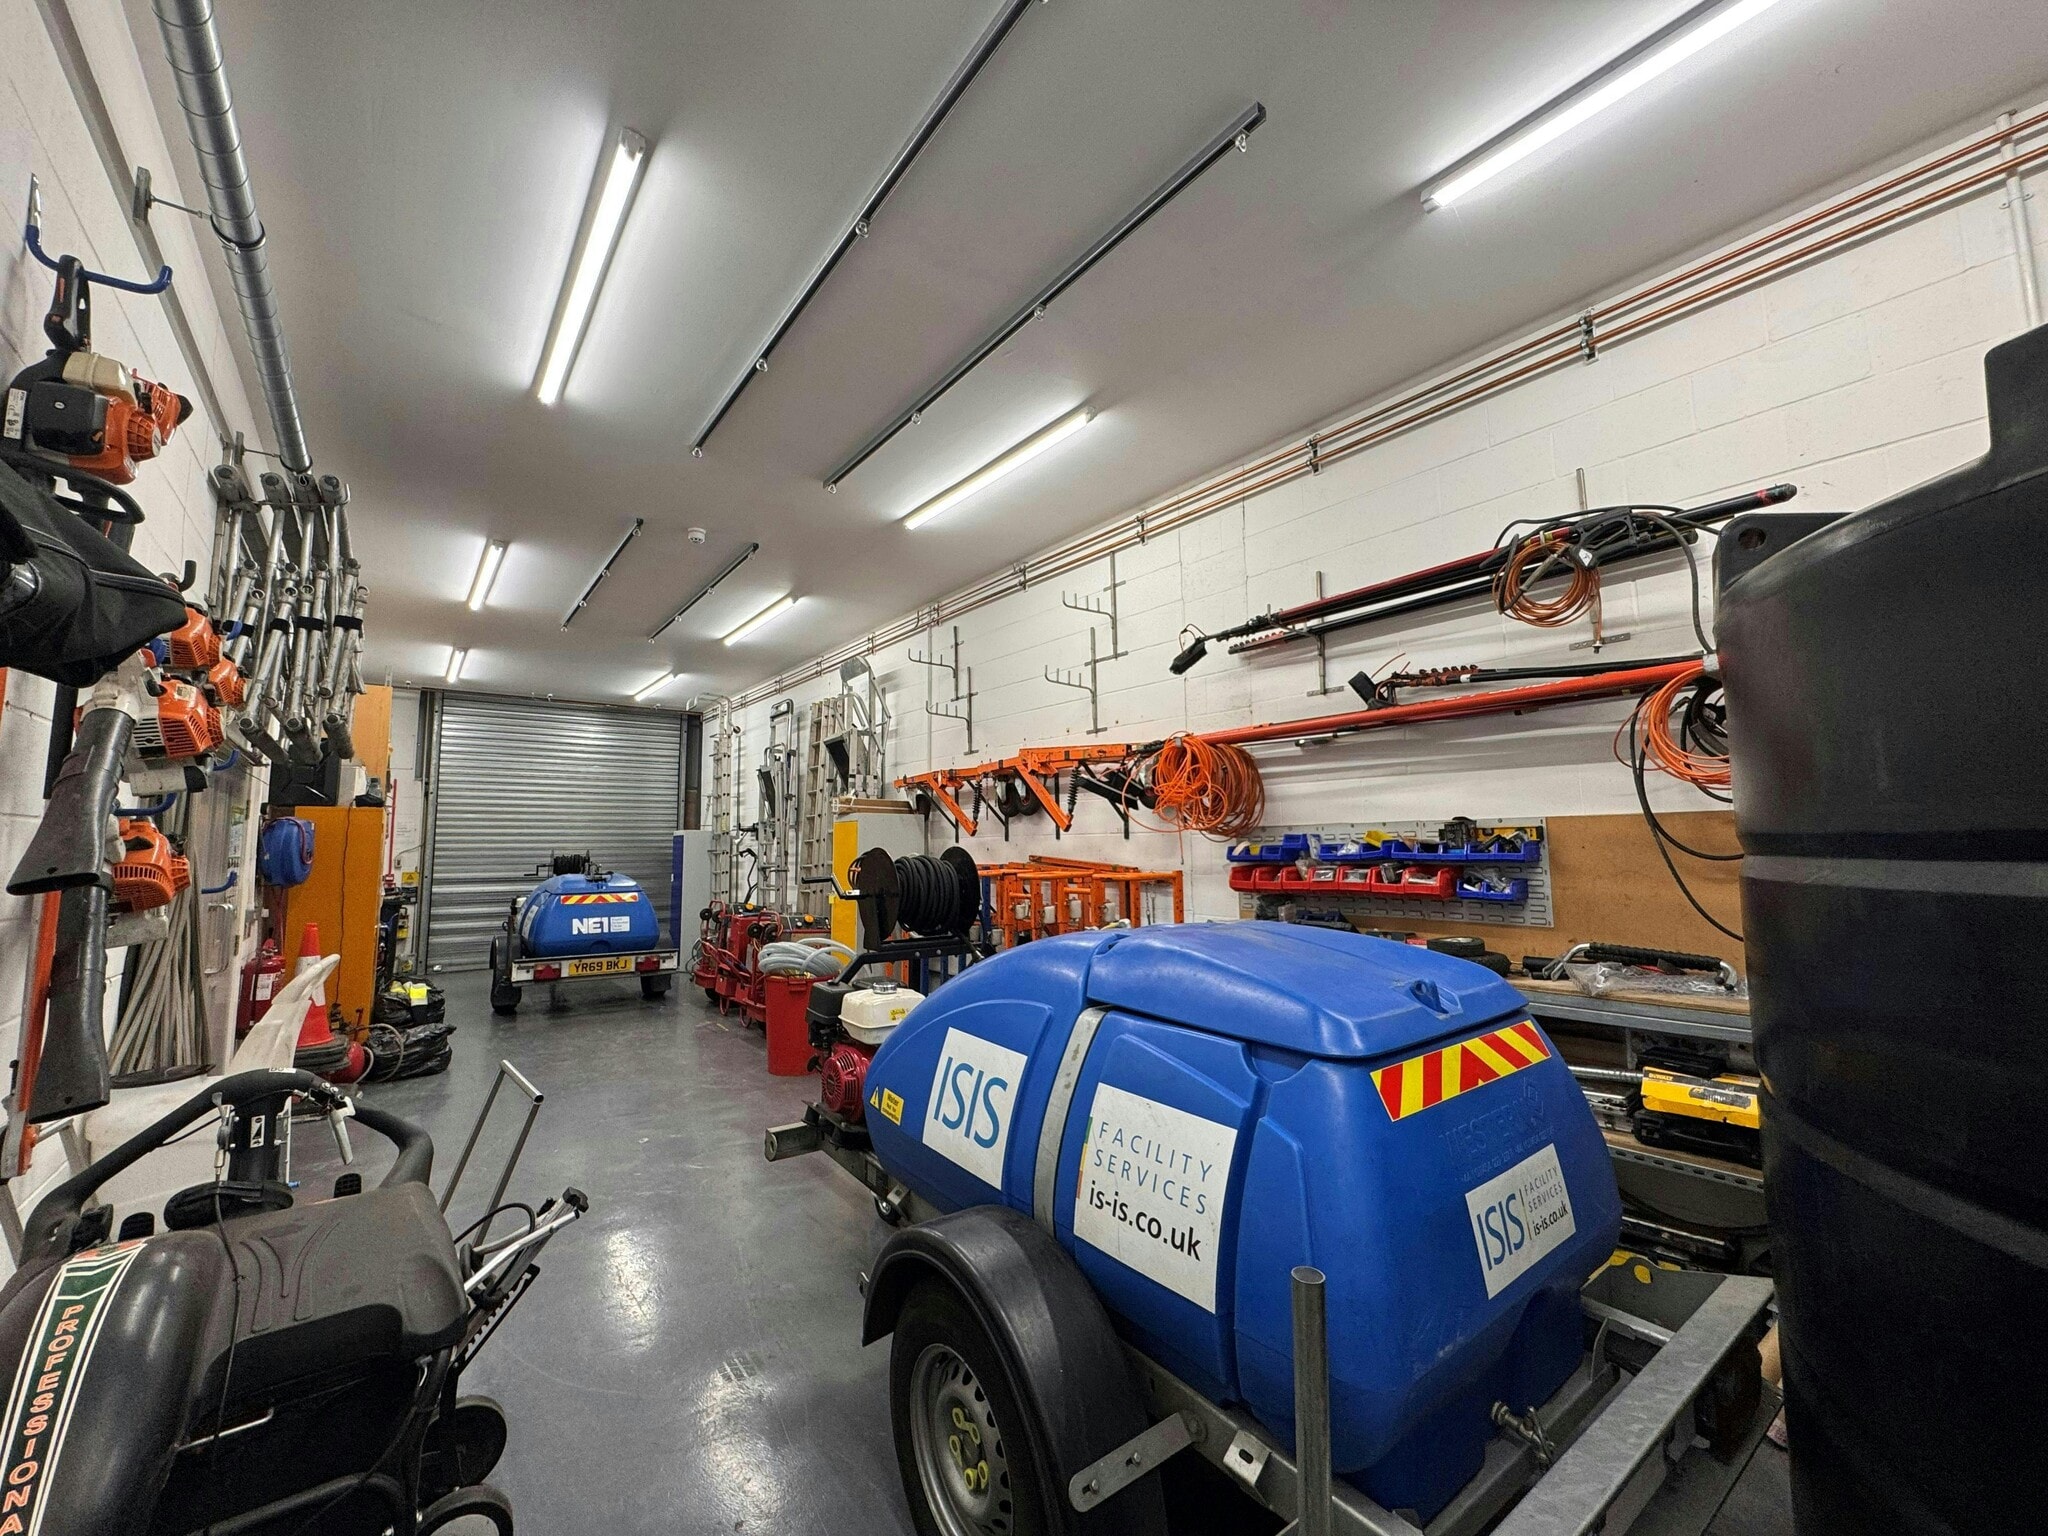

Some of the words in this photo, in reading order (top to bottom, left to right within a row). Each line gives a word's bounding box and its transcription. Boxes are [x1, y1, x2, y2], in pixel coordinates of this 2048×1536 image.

[574, 961, 603, 973] YR69
[606, 959, 627, 971] BKJ
[933, 1056, 1008, 1149] ISIS
[1094, 1149, 1207, 1215] SERVICES
[1099, 1121, 1213, 1182] FACILITY
[1524, 1167, 1559, 1196] FACILITY
[1089, 1180, 1202, 1262] is-is.co.uk
[1528, 1181, 1563, 1213] SERVICES
[1533, 1200, 1569, 1236] is-is.co.uk
[1476, 1193, 1525, 1271] ISIS
